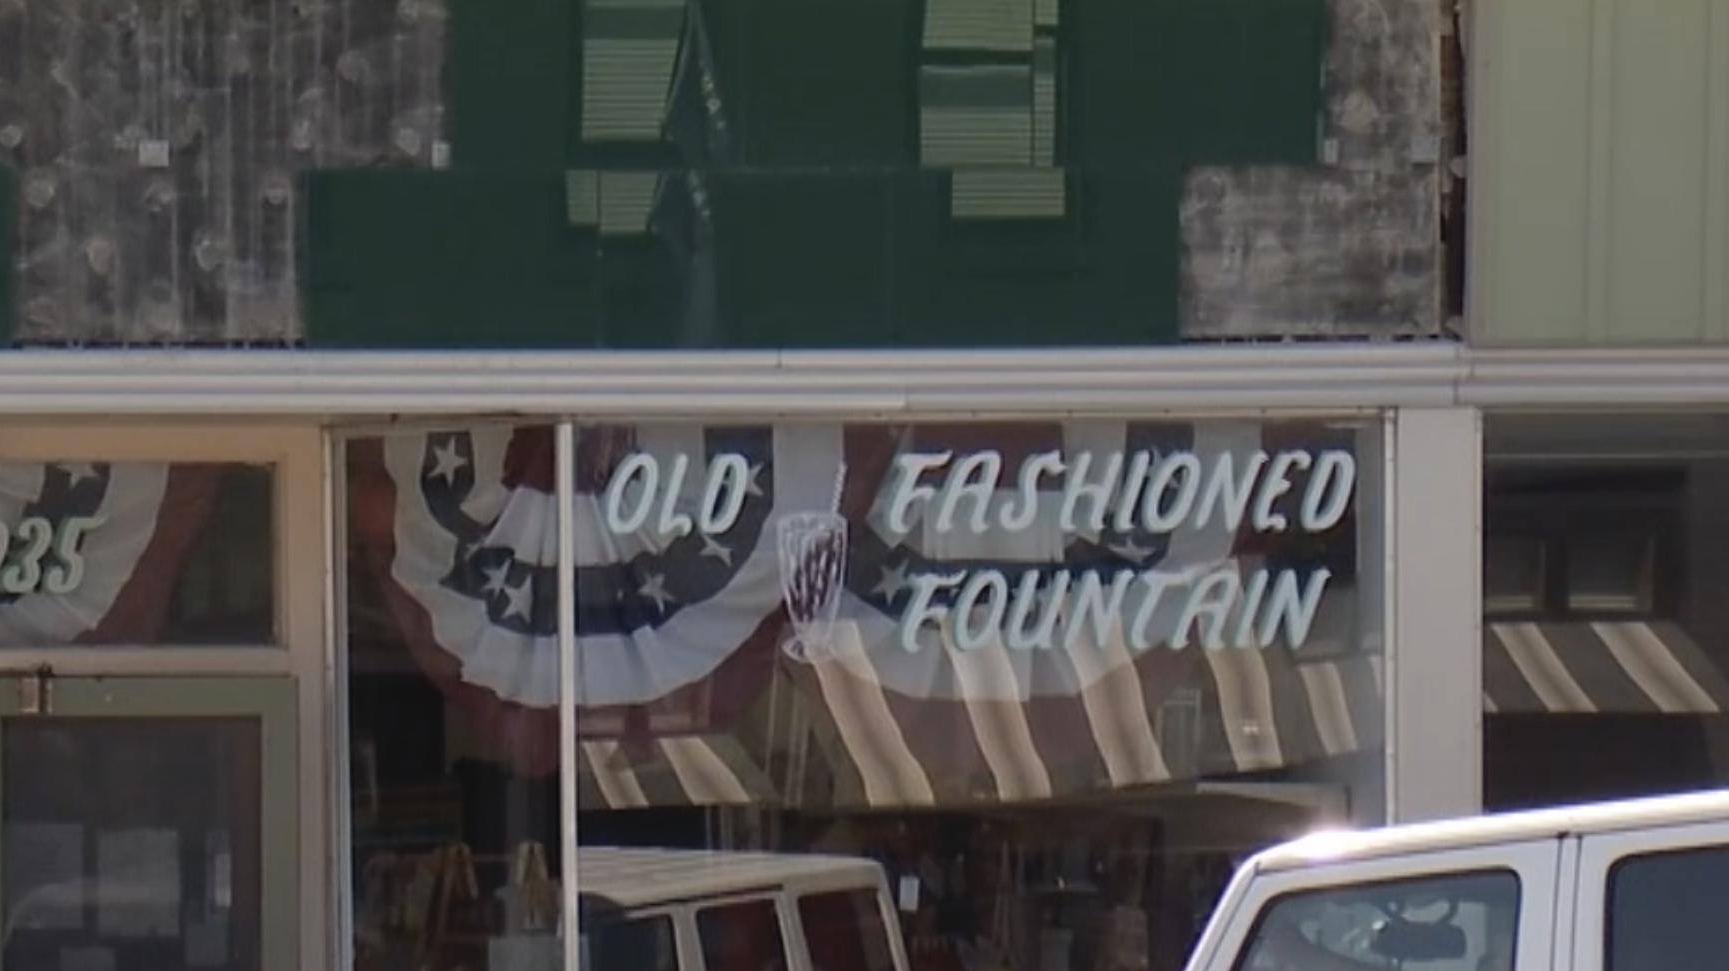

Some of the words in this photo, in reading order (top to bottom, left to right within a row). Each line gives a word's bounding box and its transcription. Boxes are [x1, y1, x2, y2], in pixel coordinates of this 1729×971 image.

[605, 453, 750, 534] OLD
[886, 450, 1358, 533] FASHIONED
[901, 567, 1332, 654] FOUNTAIN
